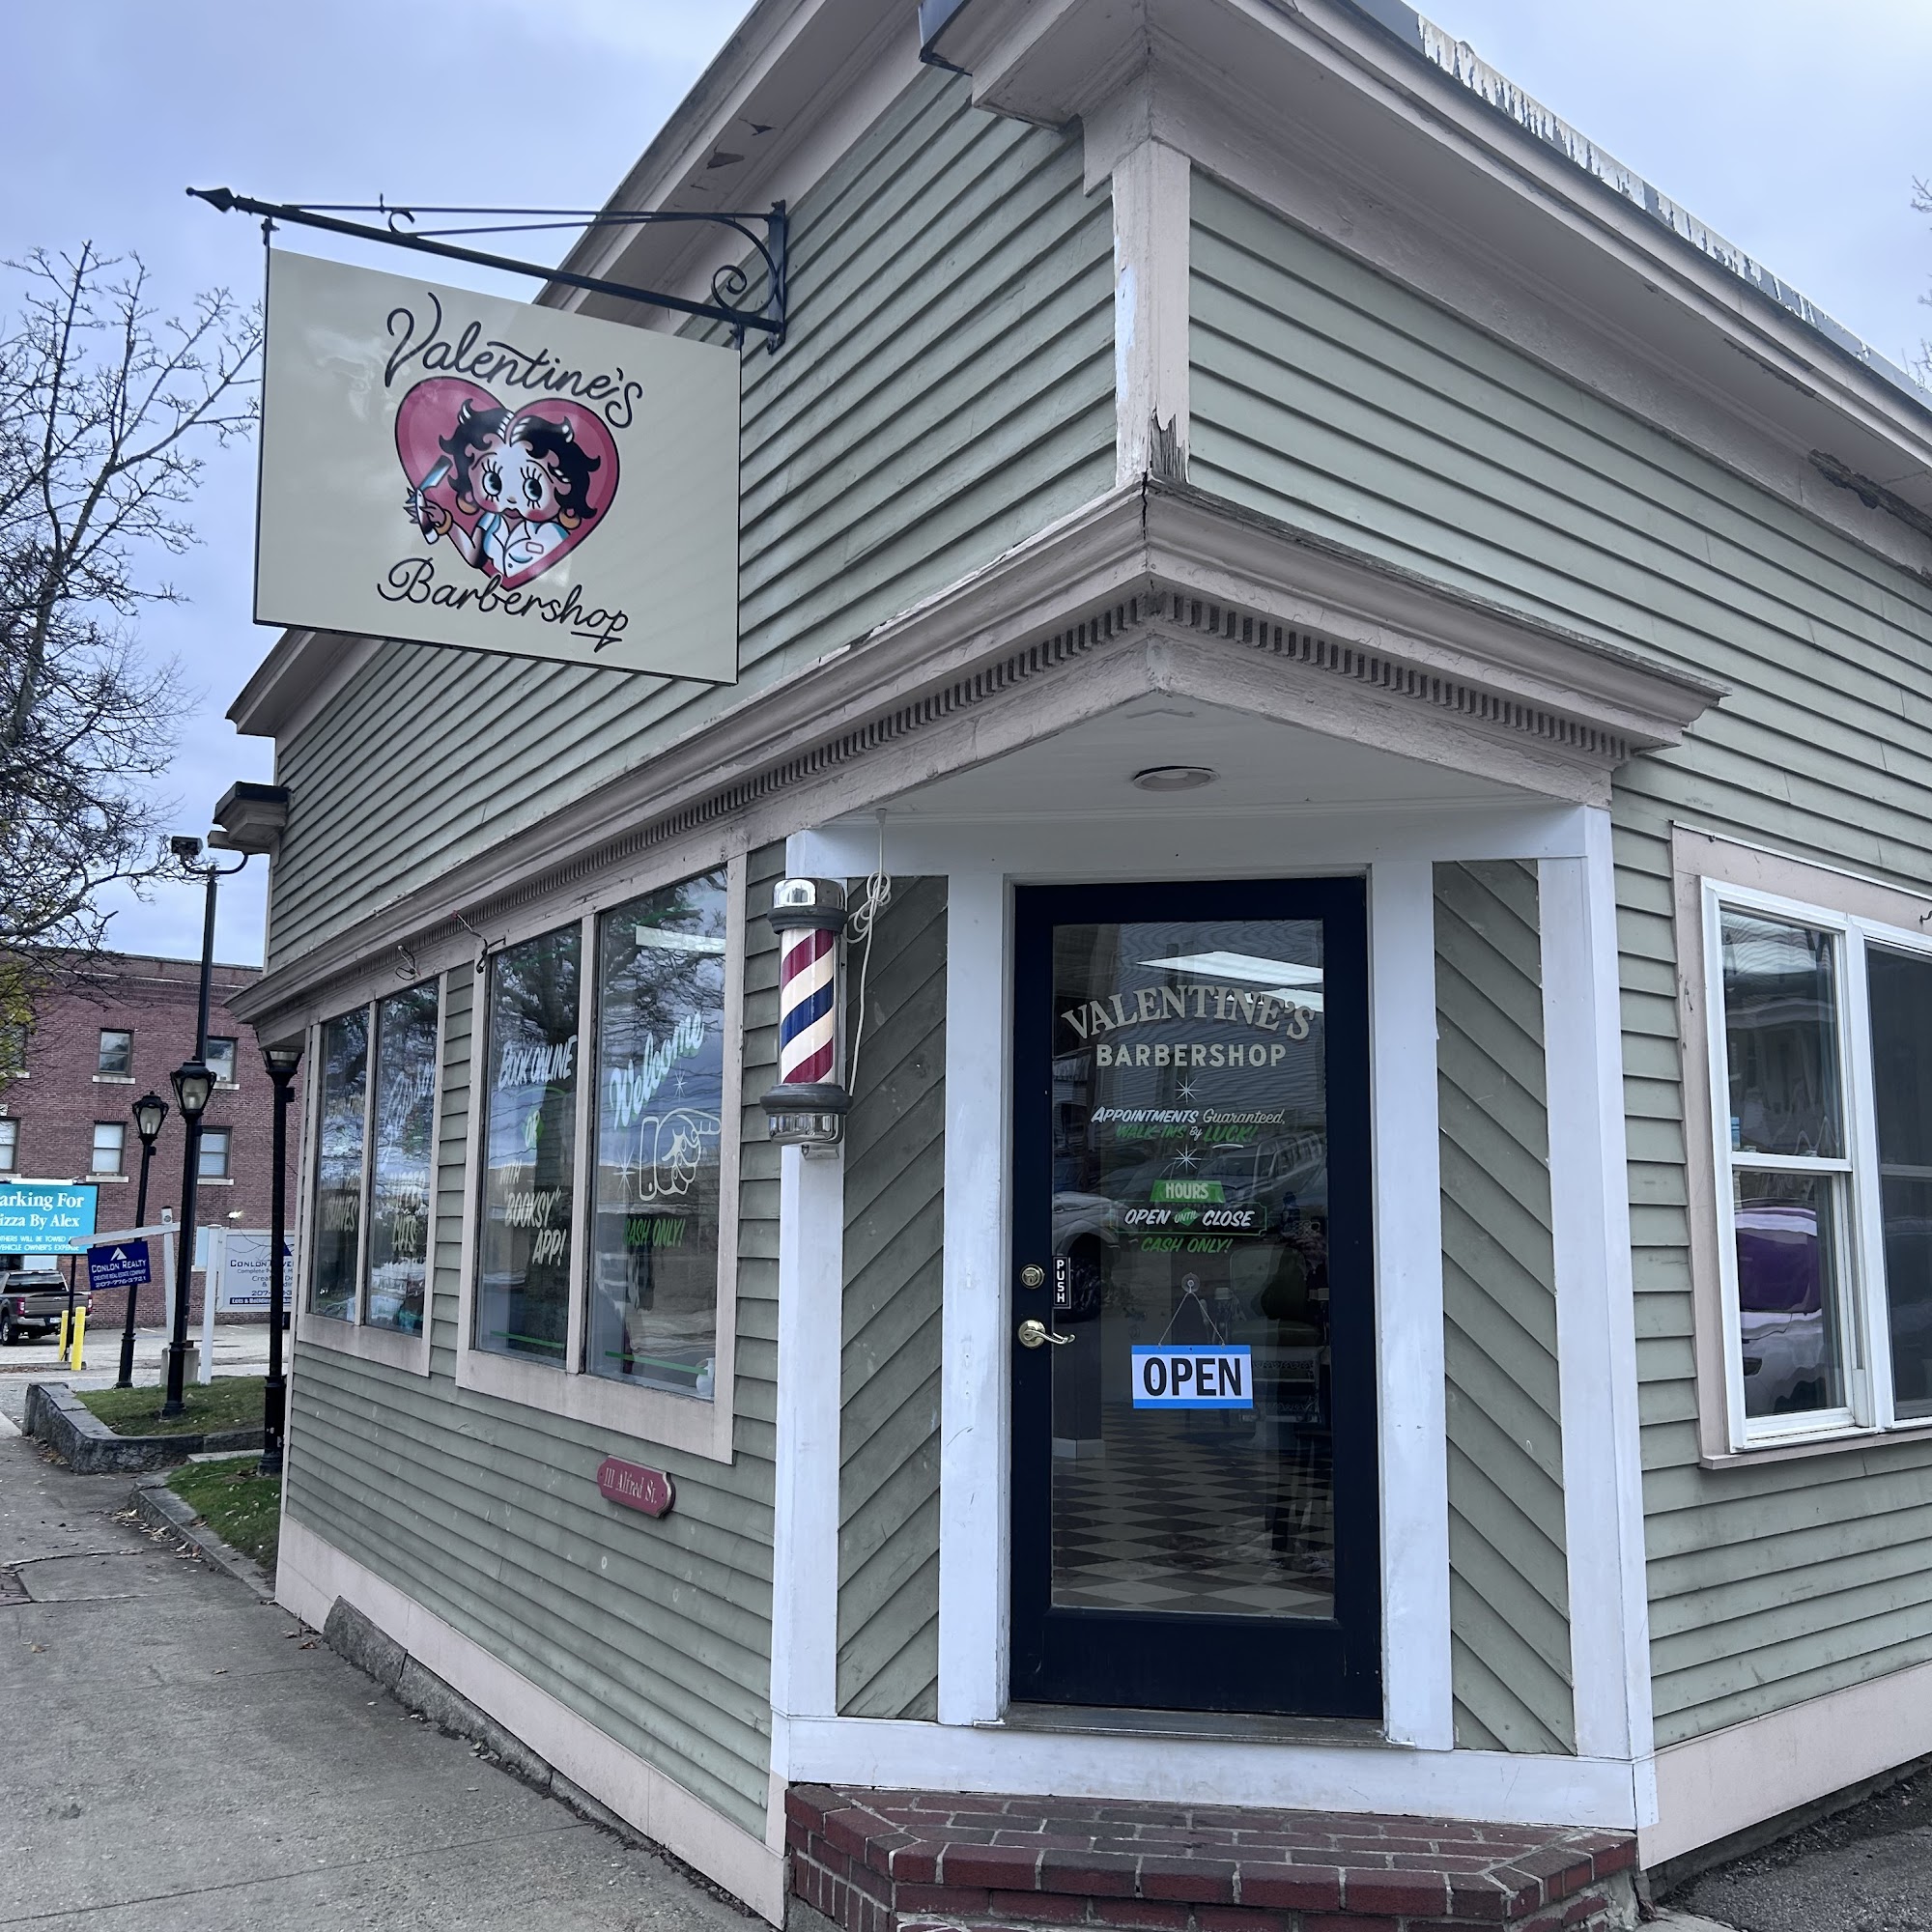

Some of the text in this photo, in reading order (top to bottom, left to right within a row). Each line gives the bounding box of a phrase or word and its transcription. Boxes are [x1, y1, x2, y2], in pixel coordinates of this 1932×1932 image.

[384, 292, 643, 429] Valentine's
[377, 556, 630, 653] Barbershop
[1061, 984, 1316, 1041] VALENTINE'S
[497, 1034, 579, 1093] BOOK ONLINE
[609, 1010, 705, 1131] Welcome
[1095, 1043, 1287, 1067] BARBERSHOP
[525, 1109, 541, 1149] OR
[1091, 1106, 1200, 1124] APPOINTMENTS
[1189, 1125, 1203, 1142] By
[1203, 1124, 1260, 1143] LUCK!
[0, 1190, 85, 1211] arking For
[1165, 1181, 1209, 1200] HOURS
[0, 1212, 80, 1231] izza By Alex
[623, 1217, 687, 1248] CASH ONLY!
[1123, 1208, 1256, 1227] OPEN UNTIL CLOSE
[531, 1228, 568, 1267] APP!
[1141, 1237, 1234, 1254] CASH ONLY!
[91, 1259, 147, 1273] CONLON REALTY
[230, 1259, 268, 1267] CONLON
[1056, 1259, 1065, 1303] PUSH
[1142, 1356, 1243, 1398] OPEN
[614, 1469, 645, 1499] Alfred
[644, 1479, 658, 1504] St.
